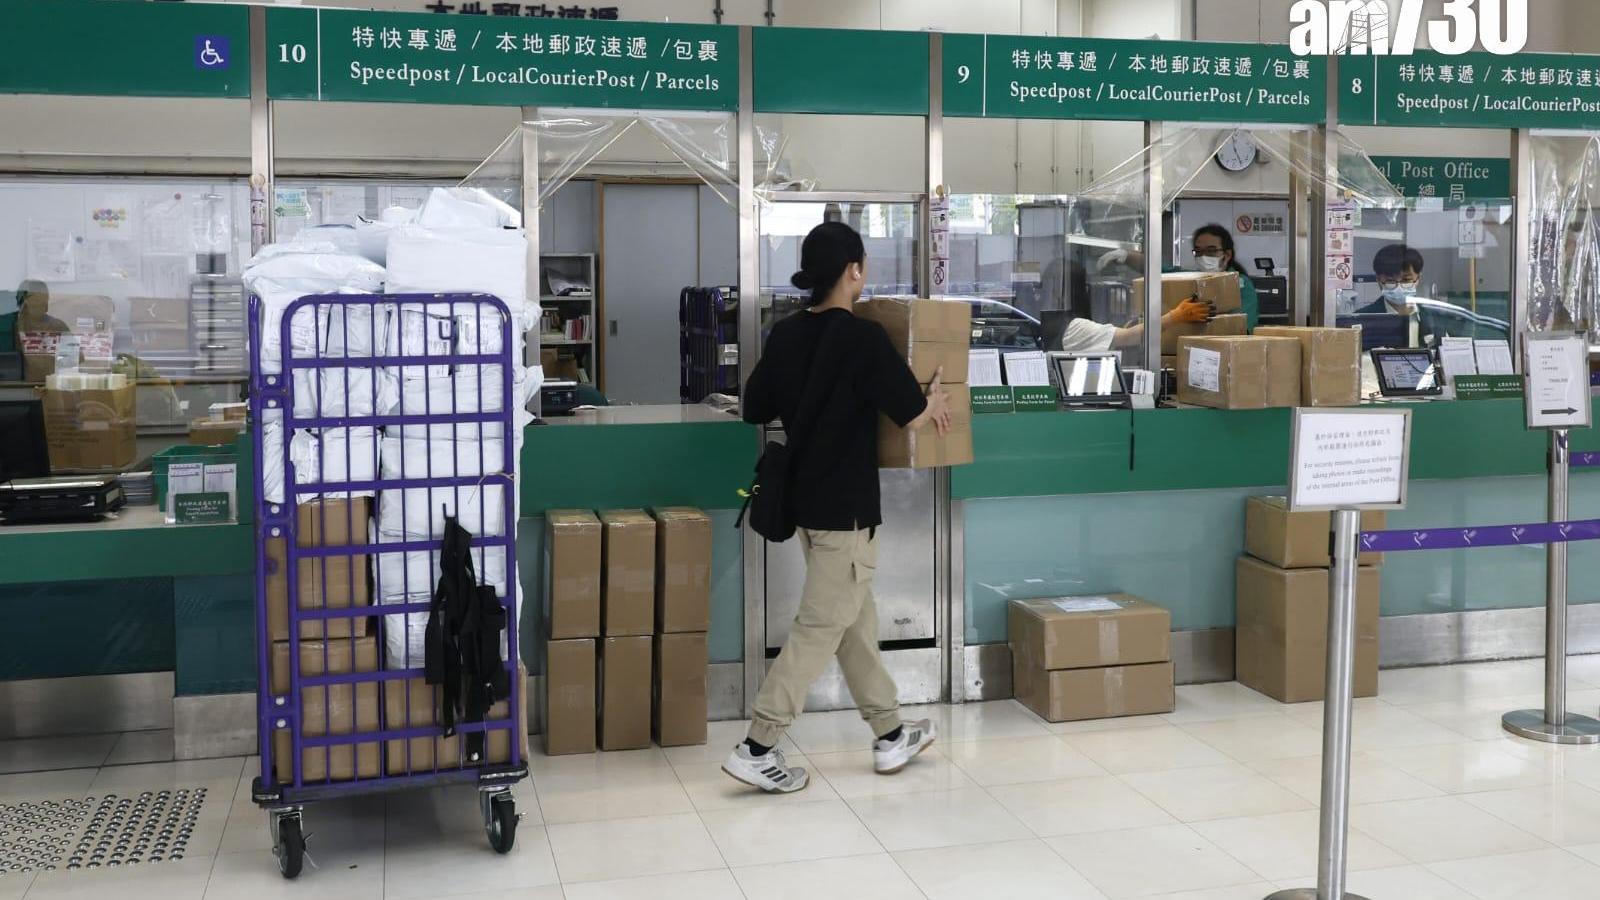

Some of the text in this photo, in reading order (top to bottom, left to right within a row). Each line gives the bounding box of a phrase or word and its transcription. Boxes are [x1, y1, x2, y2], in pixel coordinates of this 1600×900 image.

[279, 43, 306, 63] 10
[352, 26, 457, 52] 特快專遞
[495, 32, 647, 59] 本地郵政速遞
[1012, 49, 1097, 72] 特快專遞
[1128, 53, 1252, 77] 本地郵政速遞
[1399, 63, 1474, 84] 特快專遞
[350, 61, 450, 86] Speedpost
[471, 65, 635, 88] LocalCourierPost
[655, 72, 719, 91] Parcels
[957, 65, 970, 83] 9
[1010, 80, 1092, 103] Speedpost
[1109, 84, 1241, 103] LocalCourierPost
[1258, 89, 1310, 105] Parcels
[1351, 78, 1362, 94] 8
[1397, 93, 1469, 114] Speedpost
[1483, 95, 1600, 112] LocalCourierPost
[1401, 161, 1434, 178] Post
[1444, 161, 1489, 179] Office
